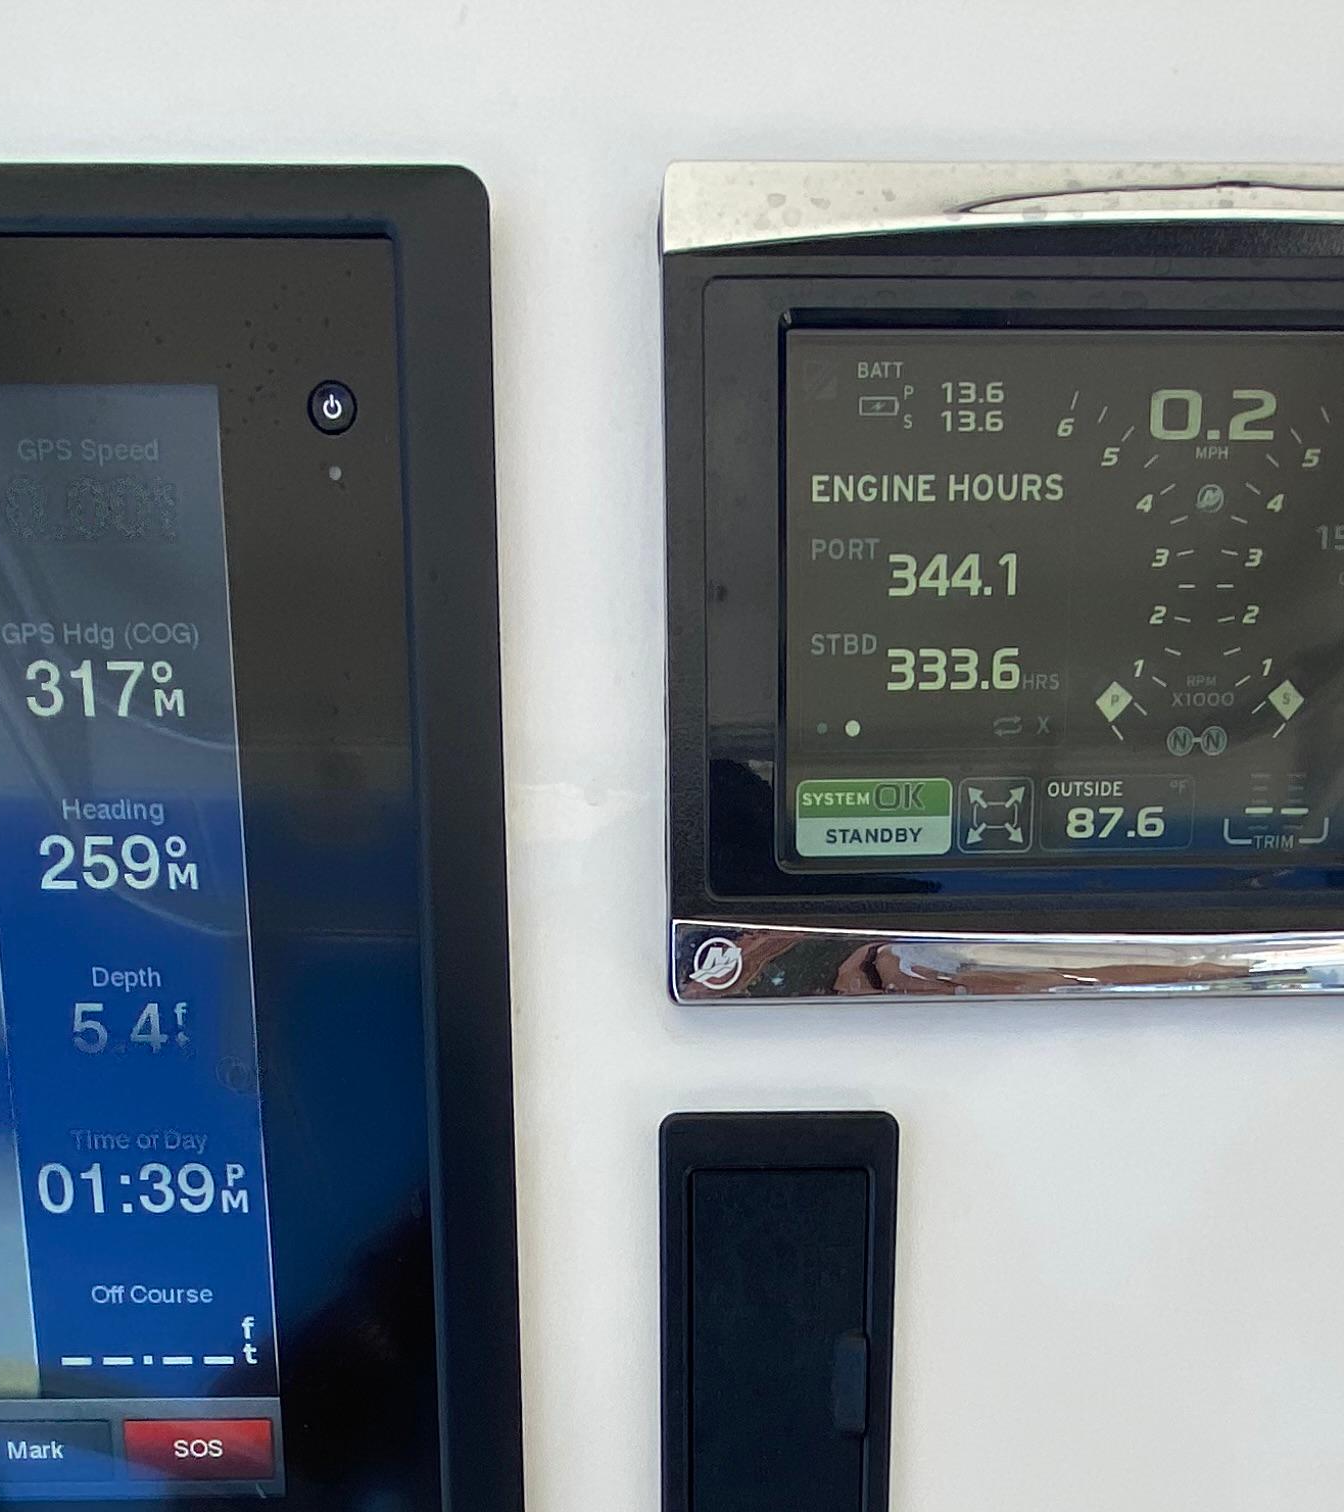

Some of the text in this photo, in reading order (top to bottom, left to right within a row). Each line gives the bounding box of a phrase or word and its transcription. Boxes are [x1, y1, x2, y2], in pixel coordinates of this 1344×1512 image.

[858, 361, 903, 379] BATT
[941, 382, 1004, 403] 13.6
[941, 410, 1004, 432] 13.6
[1149, 389, 1277, 440] 0.2
[18, 440, 159, 465] GPS Speed
[1195, 447, 1228, 460] MPH
[811, 473, 1064, 502] ENGINE HOURS
[811, 538, 1017, 597] PORT 344.1
[2, 623, 199, 649] GPS Hdg (COG)
[811, 634, 1060, 691] STBD 333.6 HRS
[1172, 692, 1234, 707] X1000
[802, 783, 925, 811] SYSTEM OK
[1047, 781, 1123, 797] OUTSIDE
[62, 799, 165, 825] Heading
[1065, 806, 1166, 840] 87.6
[825, 827, 923, 846] STANDBY
[1254, 835, 1294, 850] TRIM
[92, 967, 161, 992] Depth
[72, 1129, 132, 1150] Time
[164, 1129, 208, 1155] Day
[38, 1161, 215, 1215] 01:39
[91, 1284, 213, 1304] Off Course
[8, 1439, 64, 1459] Mark
[173, 1438, 223, 1458] SOS
